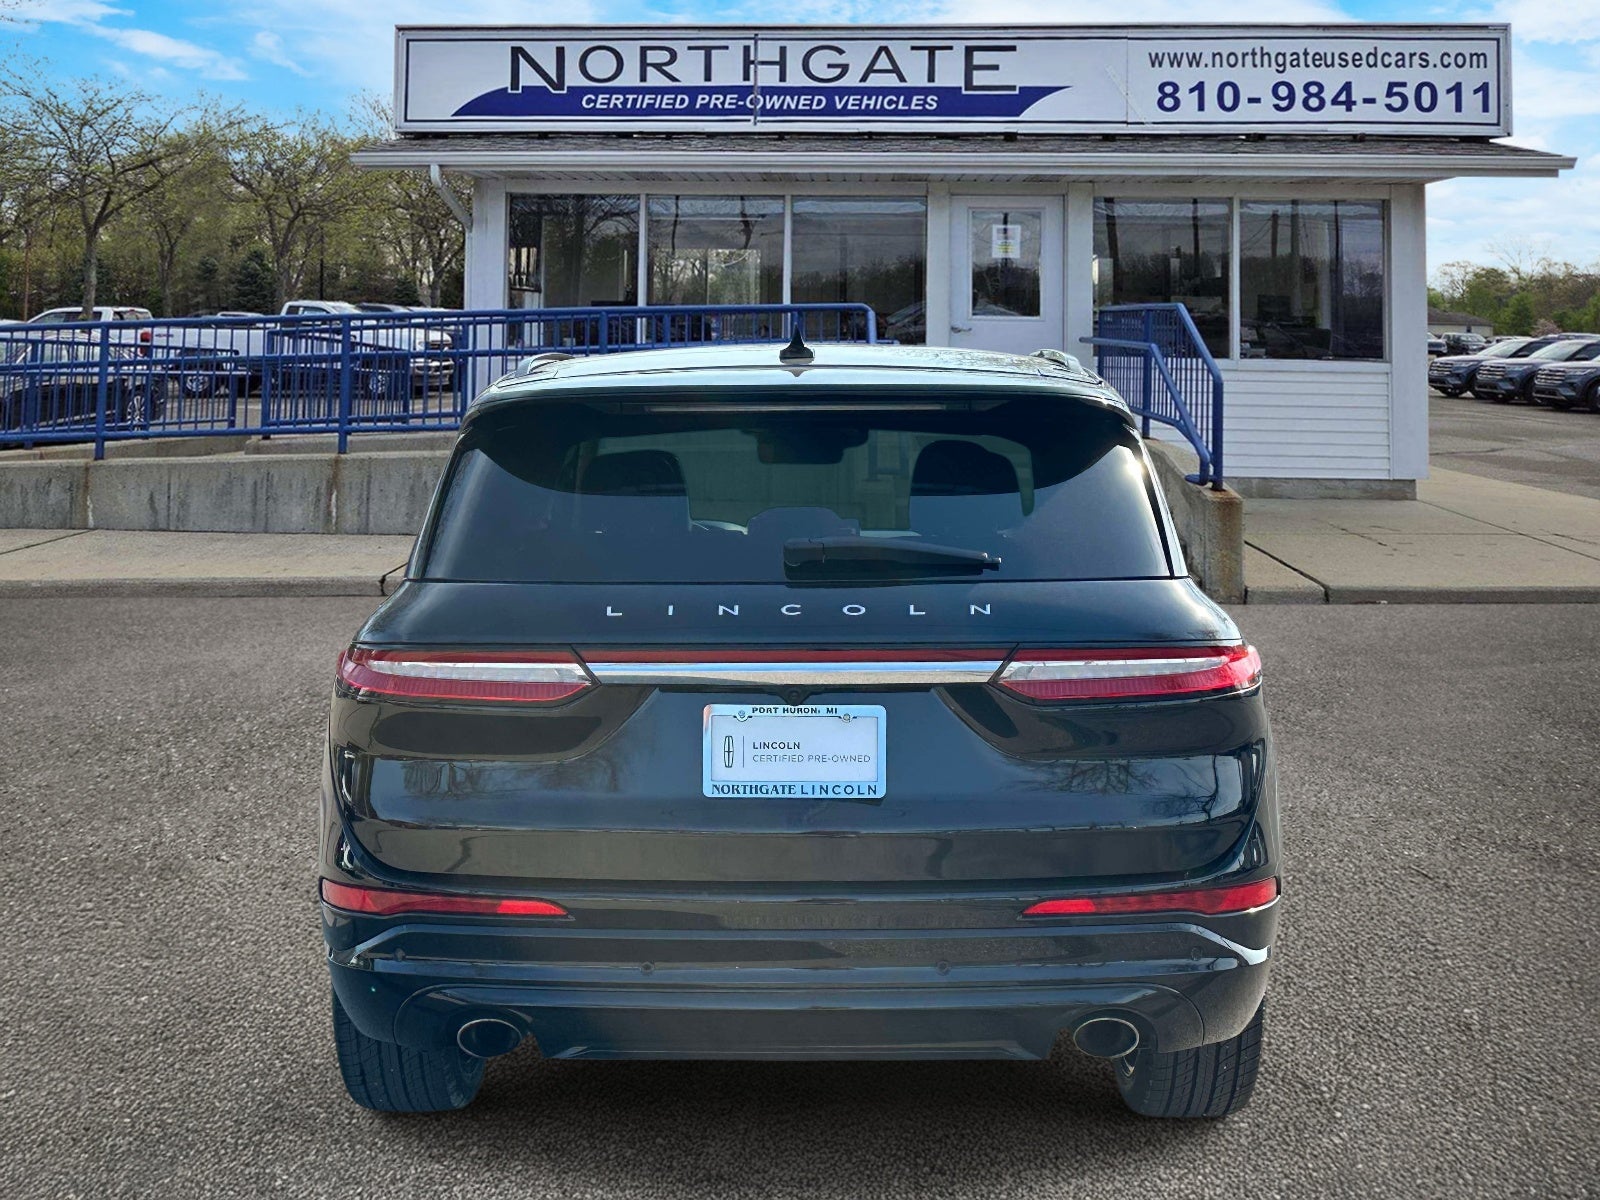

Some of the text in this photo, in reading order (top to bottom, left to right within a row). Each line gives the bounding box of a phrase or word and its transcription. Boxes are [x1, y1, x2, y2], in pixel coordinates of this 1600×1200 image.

[1148, 46, 1489, 72] www.northgateusedcars.com
[508, 44, 1018, 94] NORTHGATE
[580, 93, 939, 111] CERTIFIED PRE-OWNED VEHICLES
[1156, 79, 1491, 114] 810-984-5011
[605, 603, 992, 617] LINCOLN
[752, 741, 800, 750] LINCOLN
[752, 754, 871, 763] CERTIFIED PRE-OWNED
[711, 784, 878, 795] NORTHGATE LINCOLN
